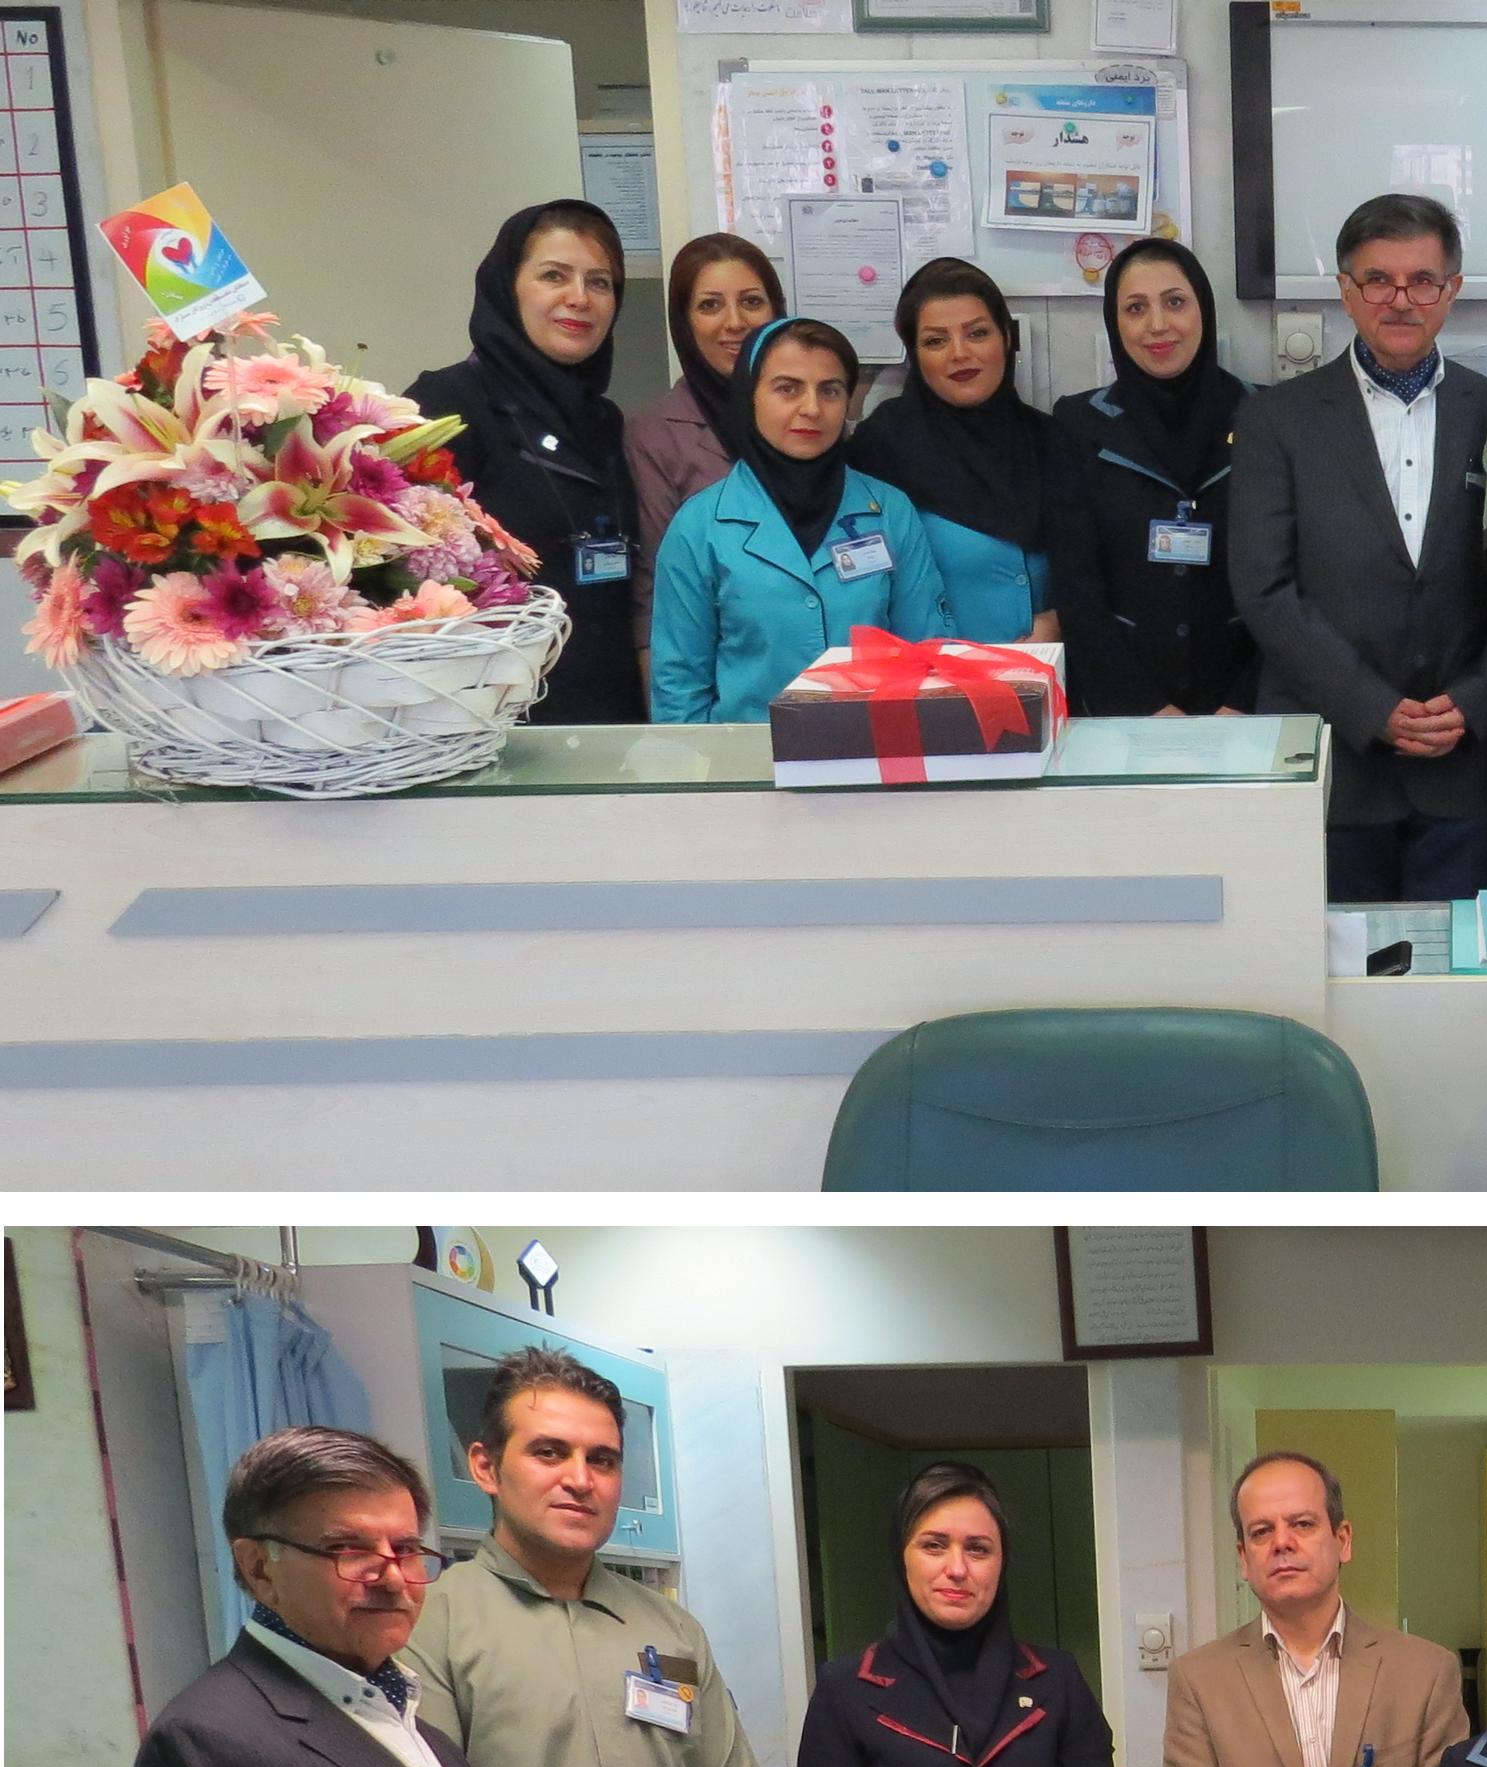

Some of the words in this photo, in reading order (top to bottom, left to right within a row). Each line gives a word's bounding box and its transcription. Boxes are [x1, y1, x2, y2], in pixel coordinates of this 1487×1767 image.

[16, 31, 39, 45] No
[1052, 131, 1090, 148] هشدار
[32, 191, 48, 217] 3
[38, 248, 58, 267] 4
[46, 302, 68, 332] 5
